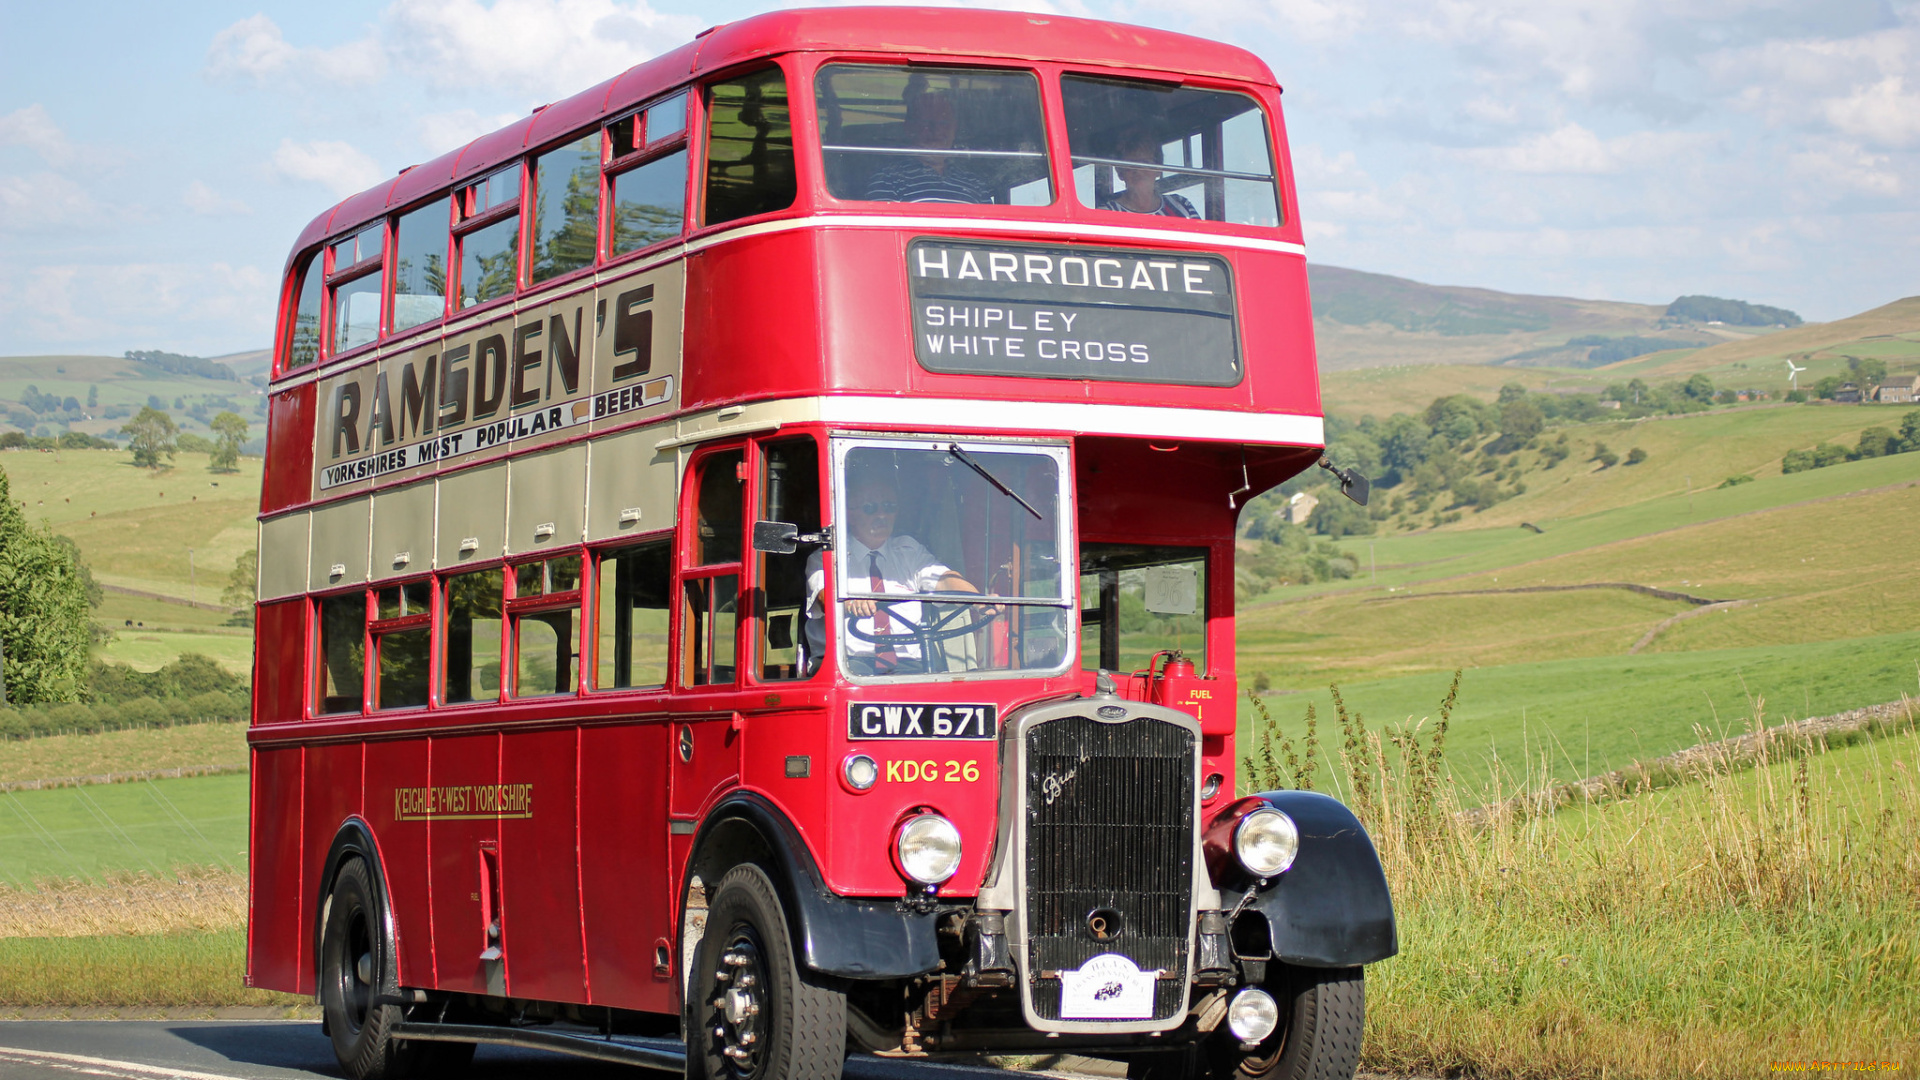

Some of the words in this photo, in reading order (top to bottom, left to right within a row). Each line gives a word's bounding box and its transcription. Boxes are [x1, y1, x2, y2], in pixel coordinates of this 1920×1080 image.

[918, 248, 1213, 294] HARROGATE
[926, 306, 1077, 332] SHIPLEY
[927, 334, 1025, 357] WHITE
[1038, 340, 1150, 363] CROSS
[332, 283, 654, 459] RAMSDEN'S
[326, 450, 406, 486] YORKSHIRES
[418, 433, 463, 463] MOST
[476, 407, 563, 448] POPULAR
[595, 386, 644, 418] BEER
[1190, 689, 1213, 699] FUEL
[861, 706, 925, 736] CWX
[932, 708, 985, 736] 671
[886, 761, 938, 783] KDG
[944, 761, 980, 783] 26
[473, 783, 533, 819] YORKSHIRE
